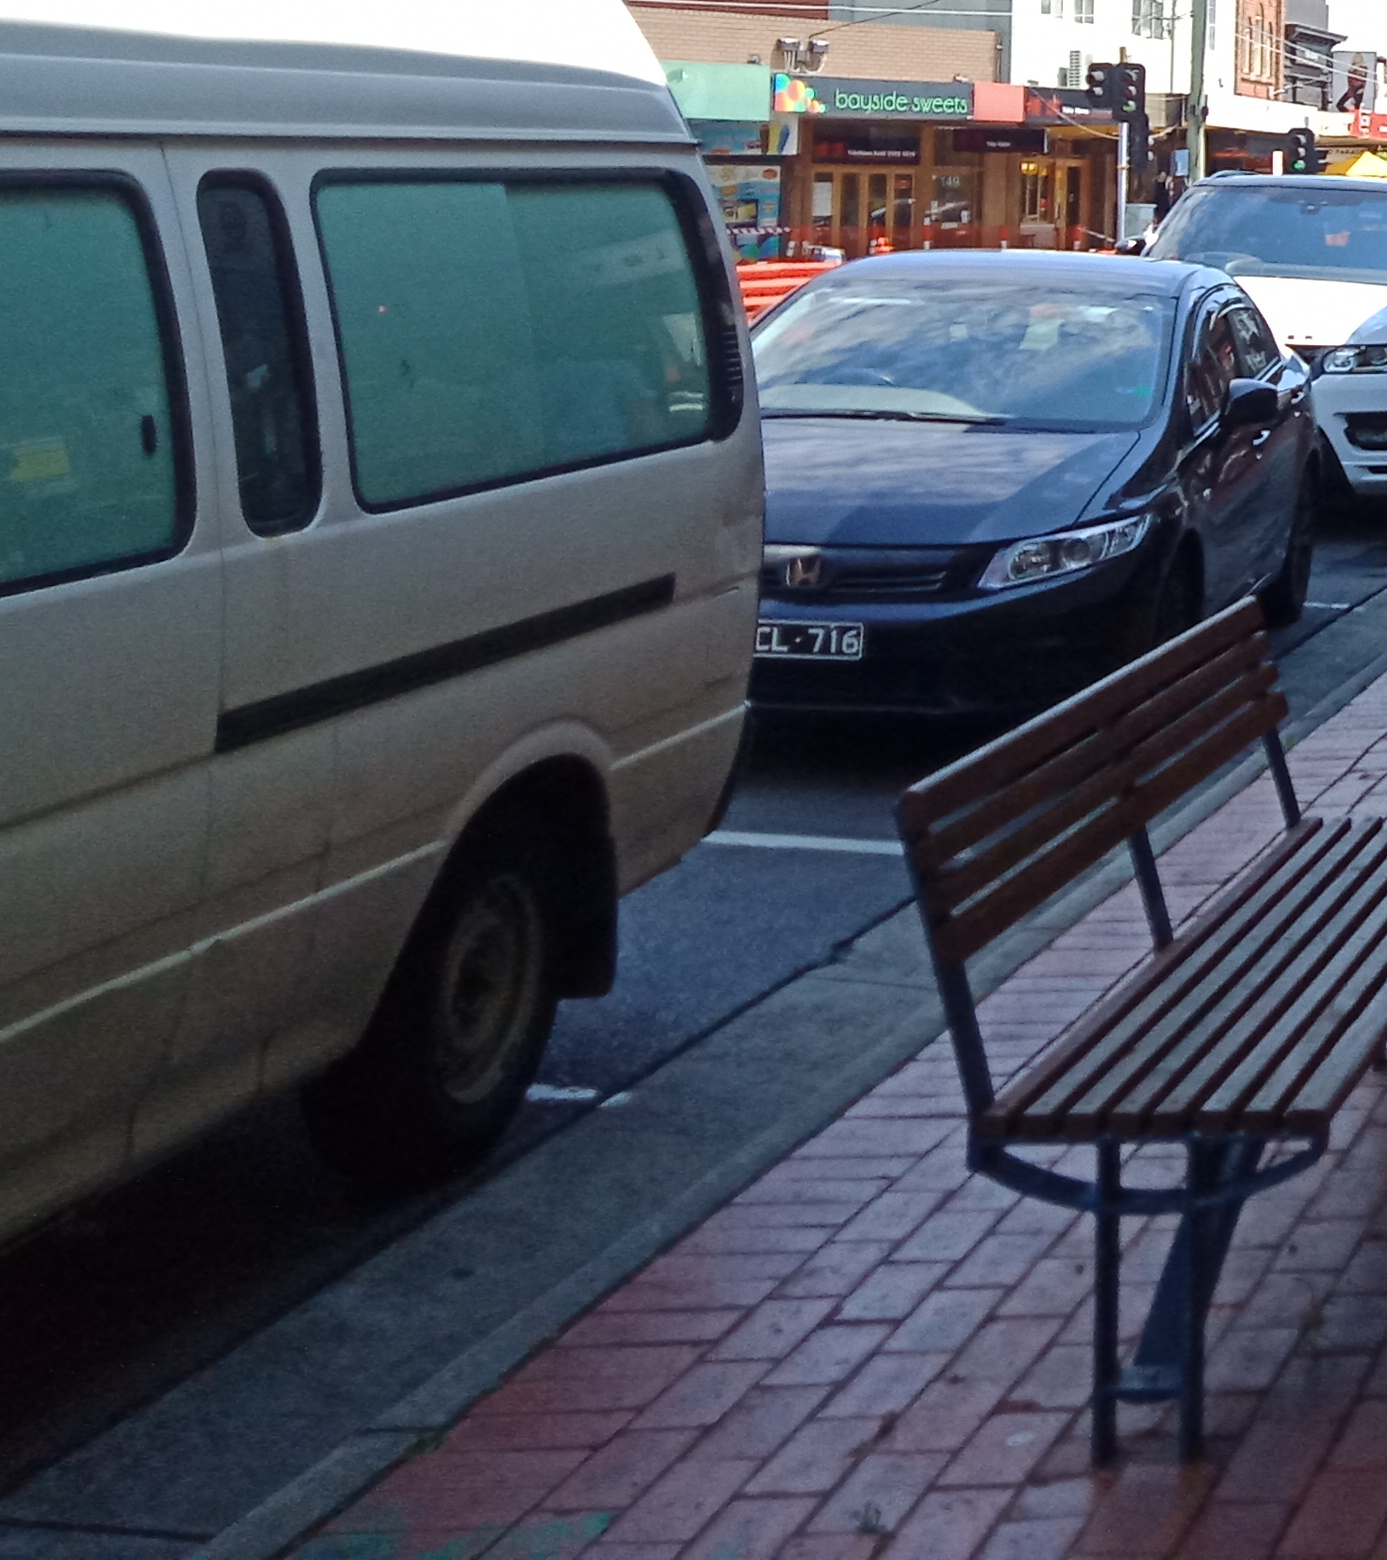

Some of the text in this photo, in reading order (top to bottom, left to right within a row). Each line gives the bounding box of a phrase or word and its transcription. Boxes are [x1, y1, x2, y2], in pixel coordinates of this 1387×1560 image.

[834, 87, 968, 114] bayside sweets
[808, 626, 860, 656] 716
